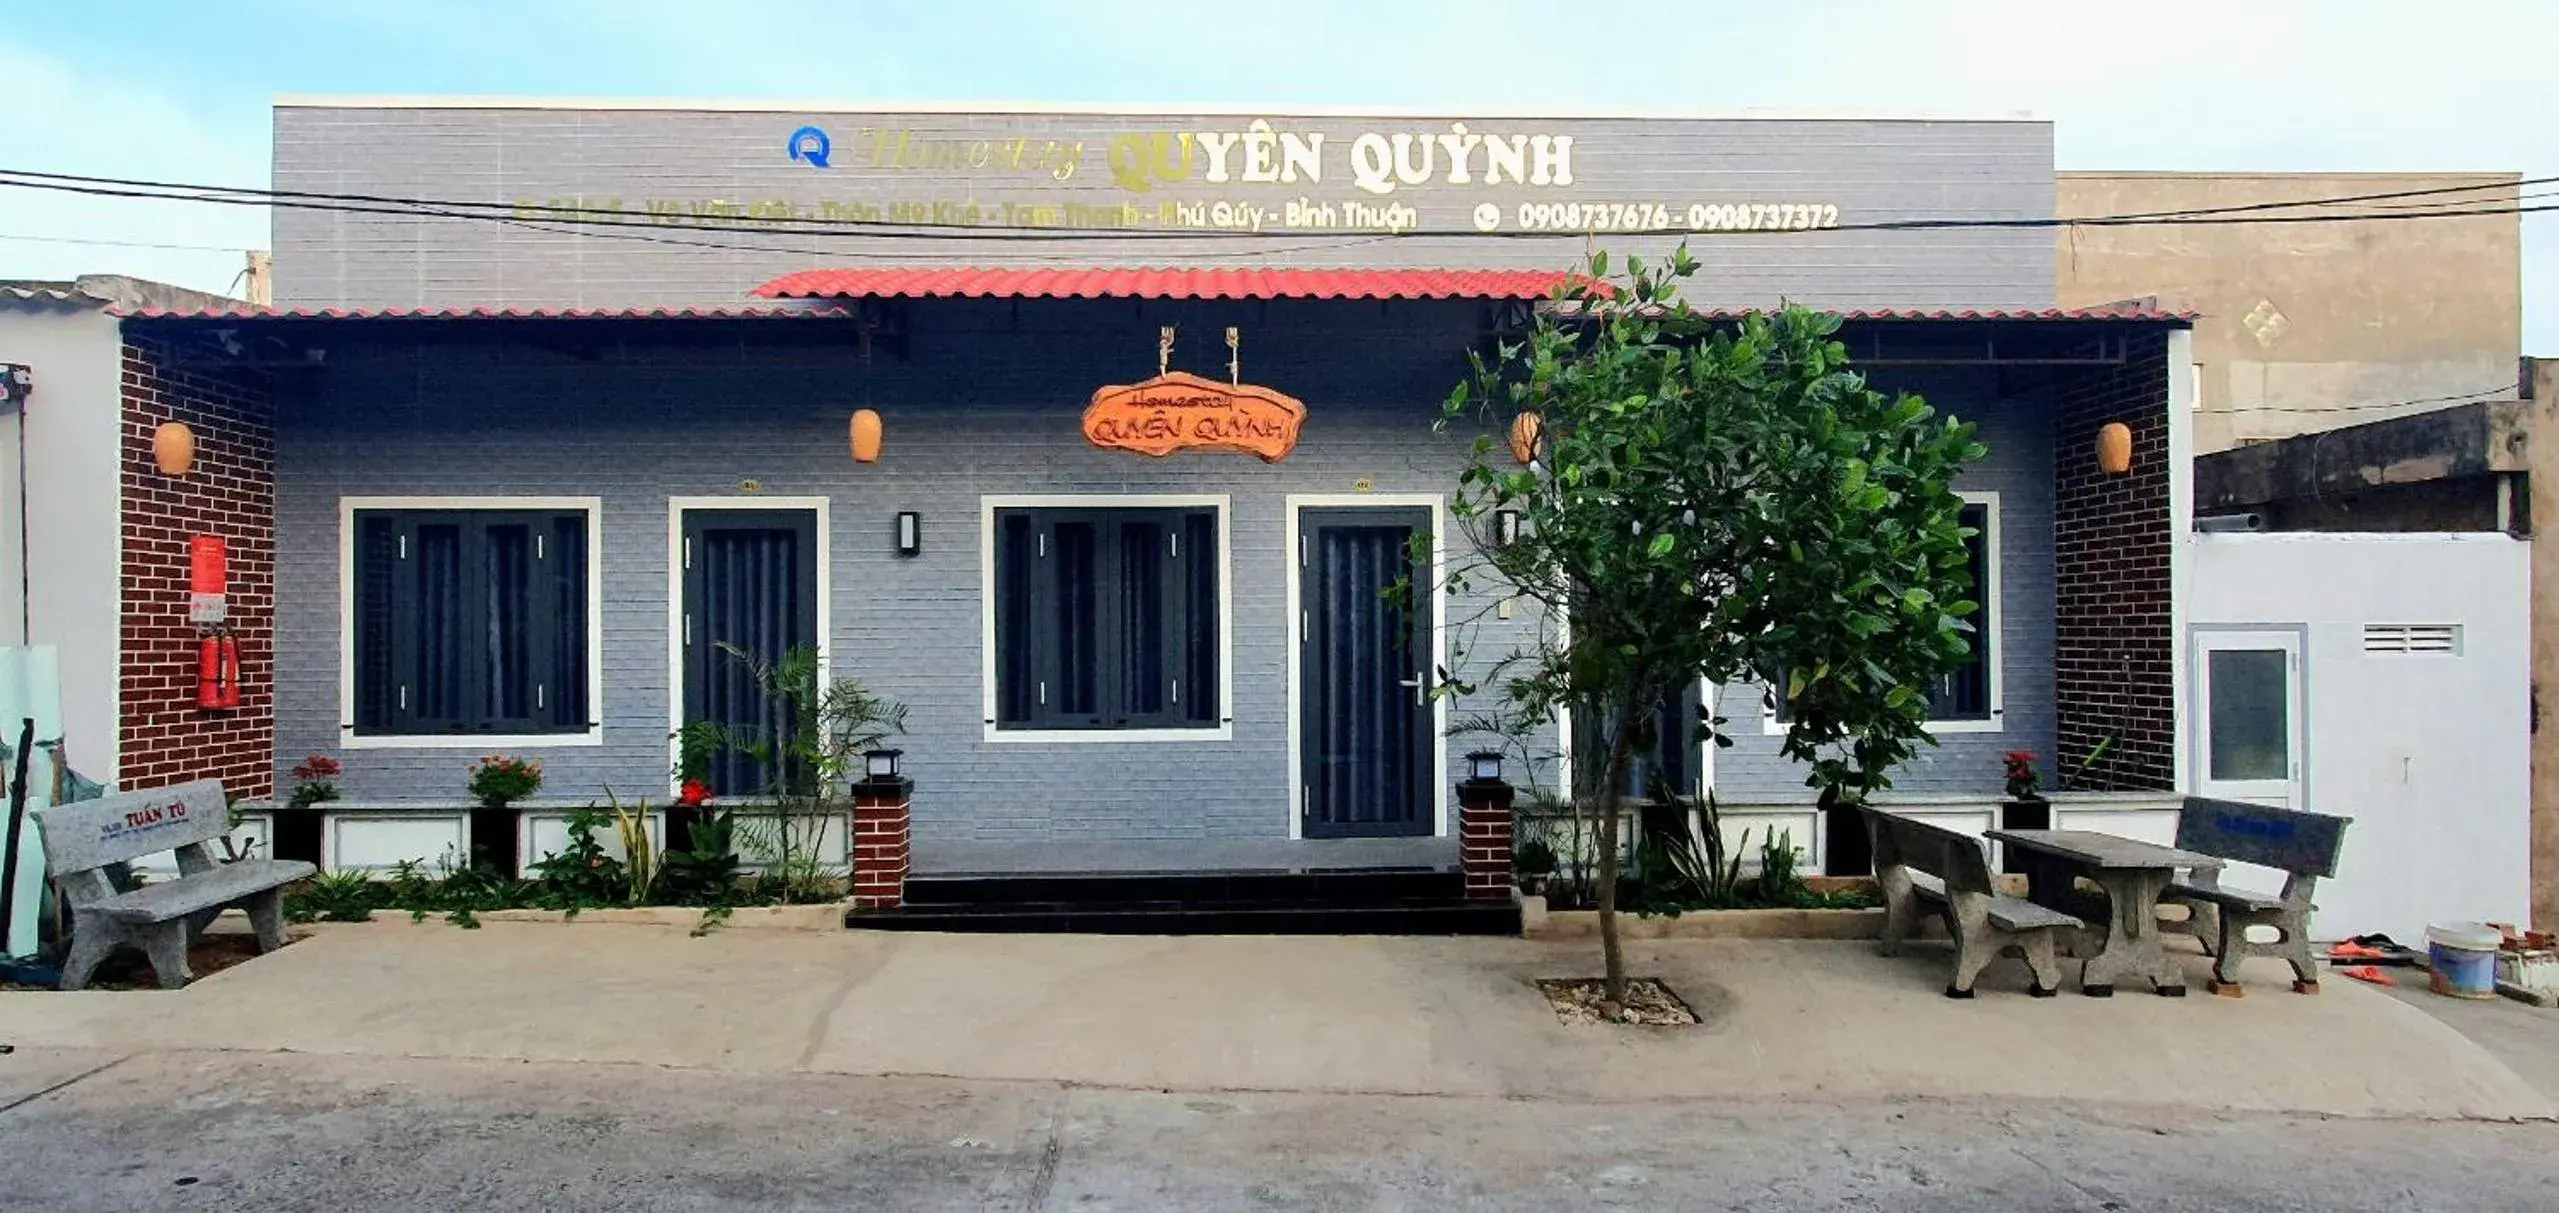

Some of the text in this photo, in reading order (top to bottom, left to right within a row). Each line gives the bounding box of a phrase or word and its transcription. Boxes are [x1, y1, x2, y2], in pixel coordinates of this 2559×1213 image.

[1106, 118, 1326, 193] QUYÊN
[1350, 122, 1576, 193] QUỲNH
[1160, 199, 1205, 228] Phú
[1518, 203, 1669, 230] 0908737676
[1687, 203, 1839, 230] 0908737372
[1093, 408, 1284, 444] QUYÊN QUỲNH
